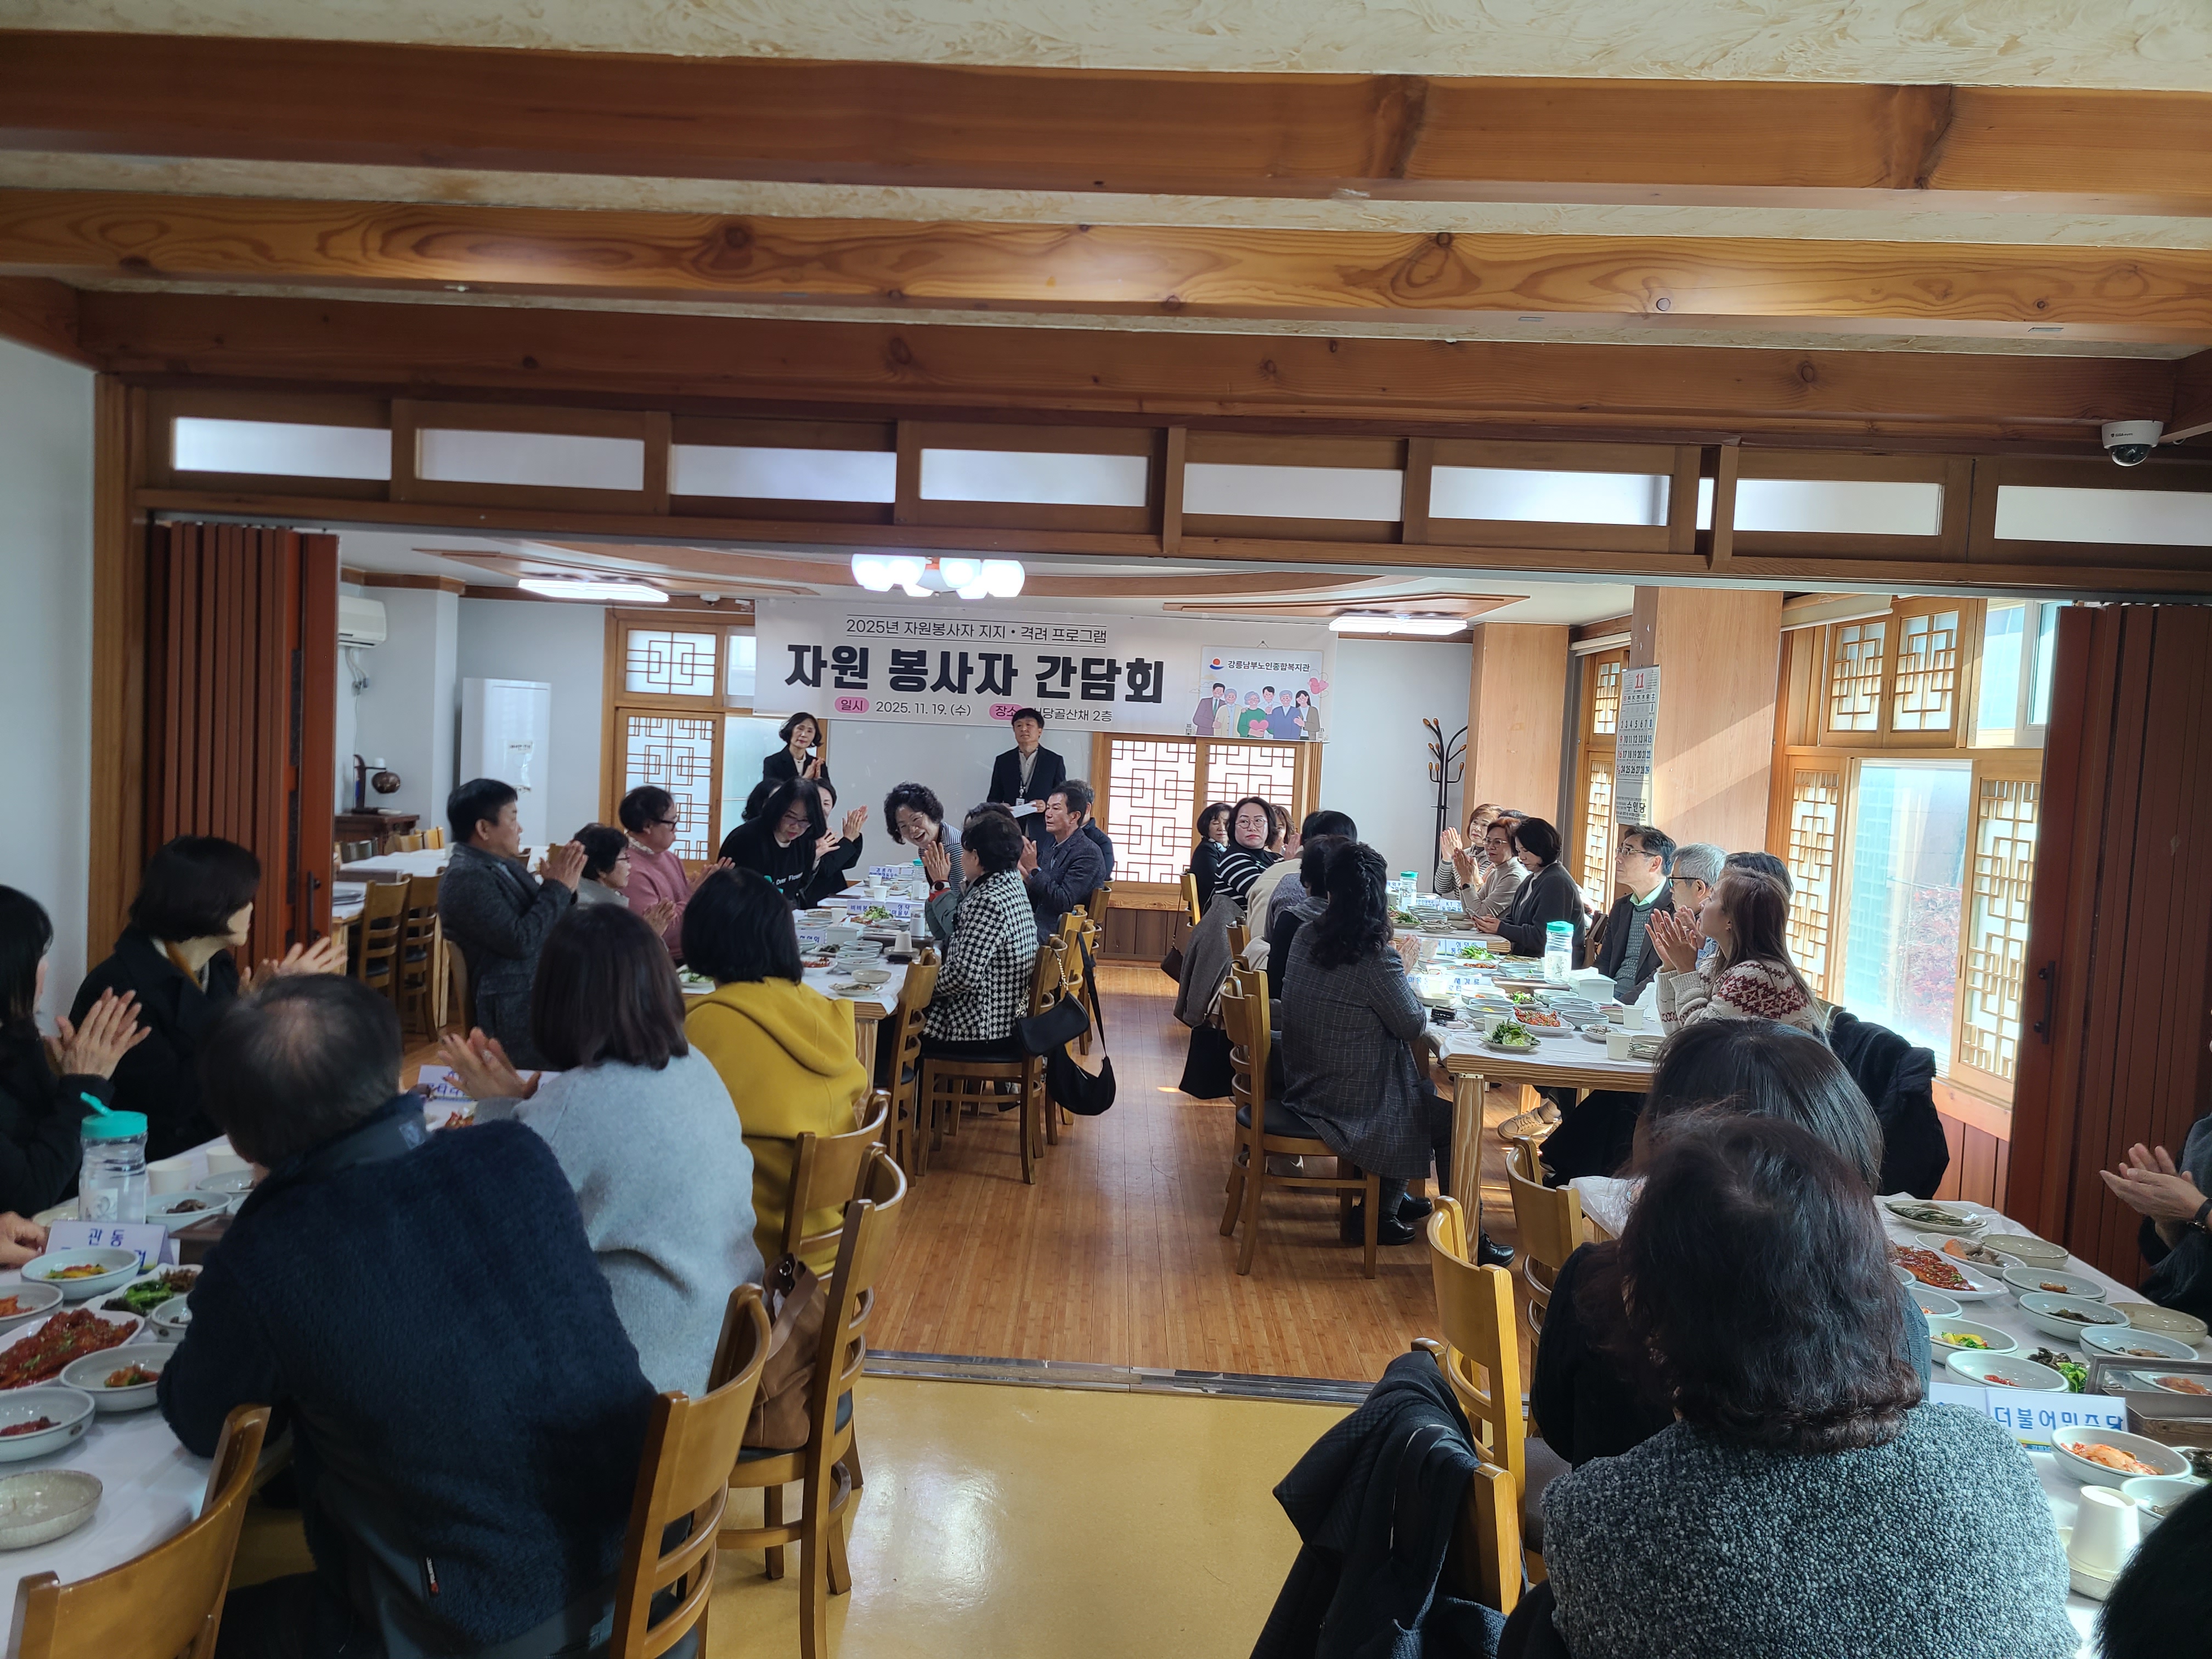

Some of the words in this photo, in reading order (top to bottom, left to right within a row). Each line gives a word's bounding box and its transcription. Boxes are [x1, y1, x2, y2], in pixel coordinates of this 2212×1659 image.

[846, 619, 899, 634] 2025년
[904, 621, 974, 638] 자원봉사자
[979, 625, 1006, 639] 지지
[1021, 627, 1047, 641] 격려
[1051, 629, 1107, 644] 프로그램
[1227, 660, 1310, 672] 강릉남부노인종합복지관
[785, 644, 869, 690] 자원
[888, 648, 1019, 697] 봉사자
[1035, 655, 1164, 704] 간담회
[1635, 673, 1644, 689] 11
[840, 699, 864, 712] 일시
[876, 701, 911, 713] 2025.
[915, 702, 928, 714] 11.
[932, 703, 947, 715] 19.
[950, 704, 972, 717] (수)
[1092, 710, 1113, 722] 2층
[1621, 720, 1624, 729] 2
[1625, 720, 1628, 729] 3
[1629, 720, 1633, 729] 4
[1634, 720, 1638, 729] 5
[1640, 719, 1643, 728] 6
[1644, 719, 1647, 728] 7
[1649, 719, 1652, 727] 8
[1620, 735, 1623, 743] 9
[1624, 735, 1628, 743] 10
[1628, 735, 1632, 743] 11
[1633, 735, 1637, 743] 12
[1638, 735, 1643, 743] 13
[1643, 735, 1647, 743] 14
[1647, 735, 1652, 743] 15
[1618, 750, 1622, 759] 16
[1623, 750, 1627, 758] 17
[1628, 750, 1632, 759] 18
[1632, 750, 1637, 759] 19
[1637, 750, 1641, 759] 20
[1642, 750, 1646, 759] 21
[1646, 750, 1650, 759] 22
[1626, 801, 1646, 813] 수인당
